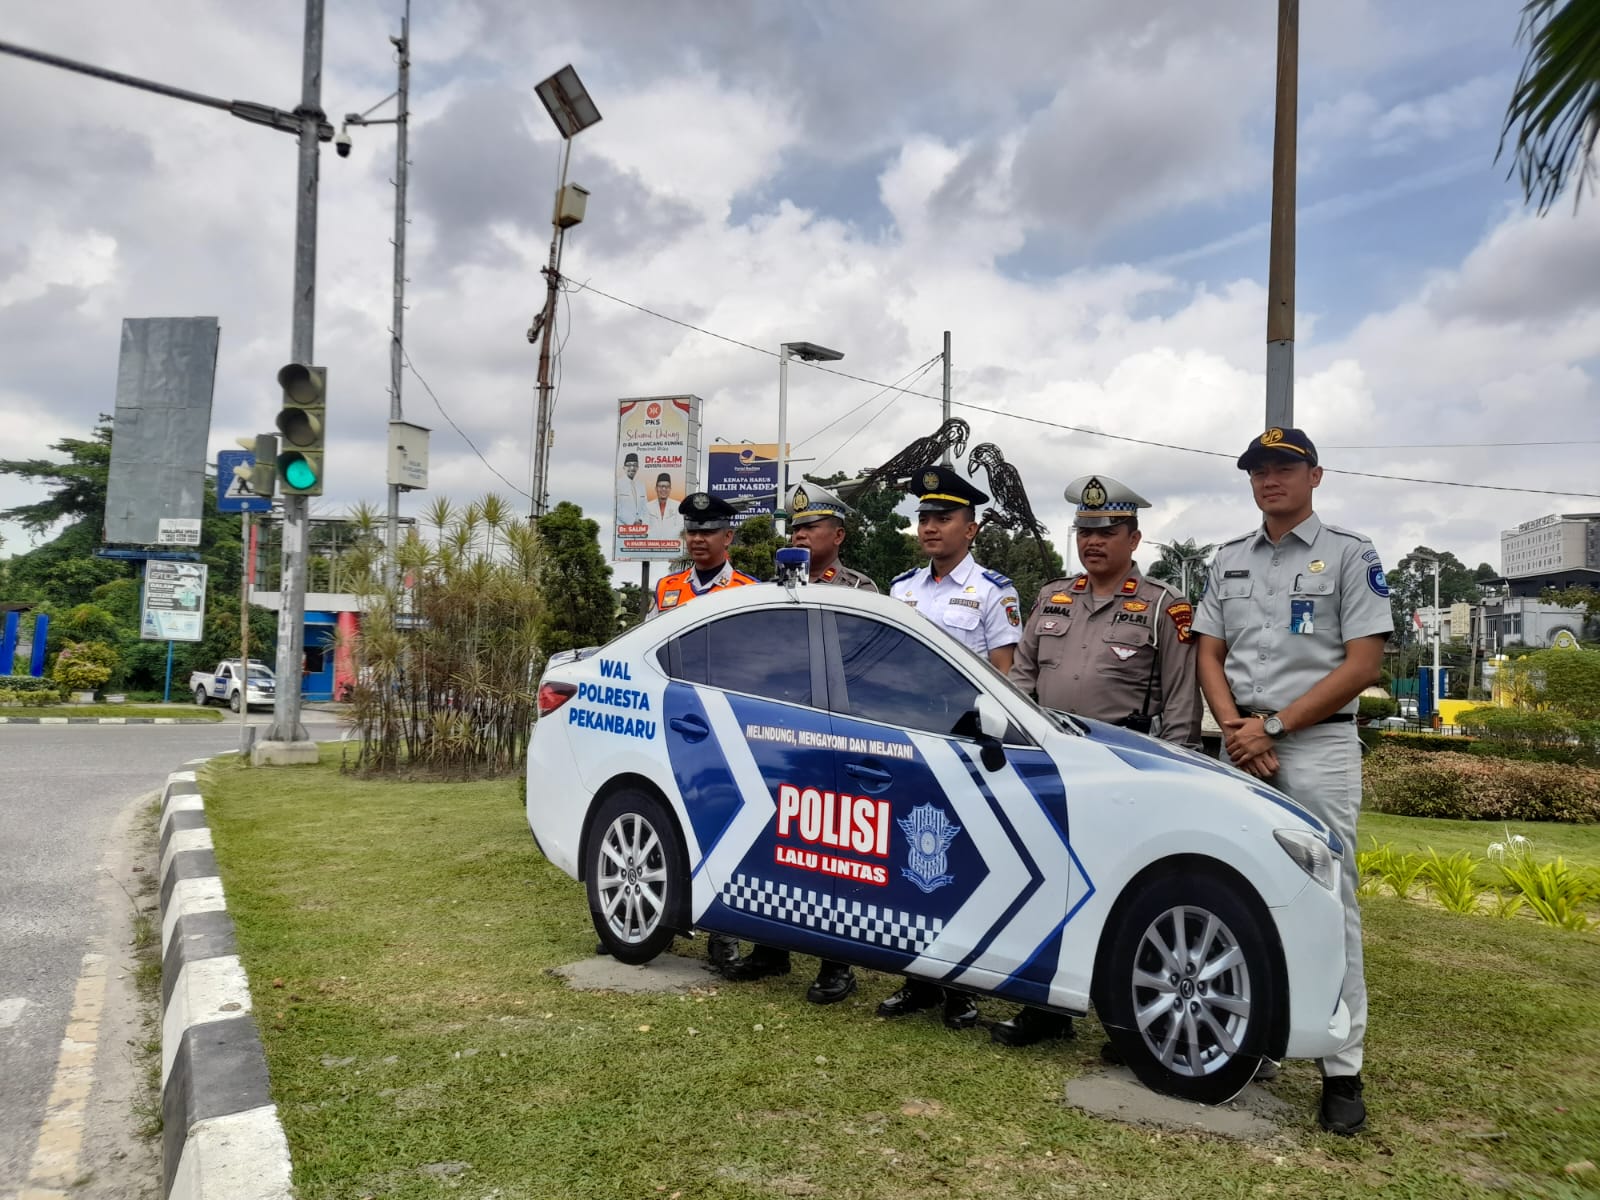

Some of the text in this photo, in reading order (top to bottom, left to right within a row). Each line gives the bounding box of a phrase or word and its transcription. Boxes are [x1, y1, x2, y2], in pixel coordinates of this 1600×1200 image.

[711, 483, 778, 491] MILIH NASDEM
[1043, 606, 1070, 617] KAMAL
[599, 658, 632, 681] WAL
[577, 682, 650, 711] POLRESTA
[568, 707, 656, 740] PEKANBARU
[746, 724, 914, 760] MELINDUNGI, MENGAYOMI DAN MELAYANI
[777, 783, 891, 857] POLISI
[775, 846, 888, 885] LALU LINTAS
